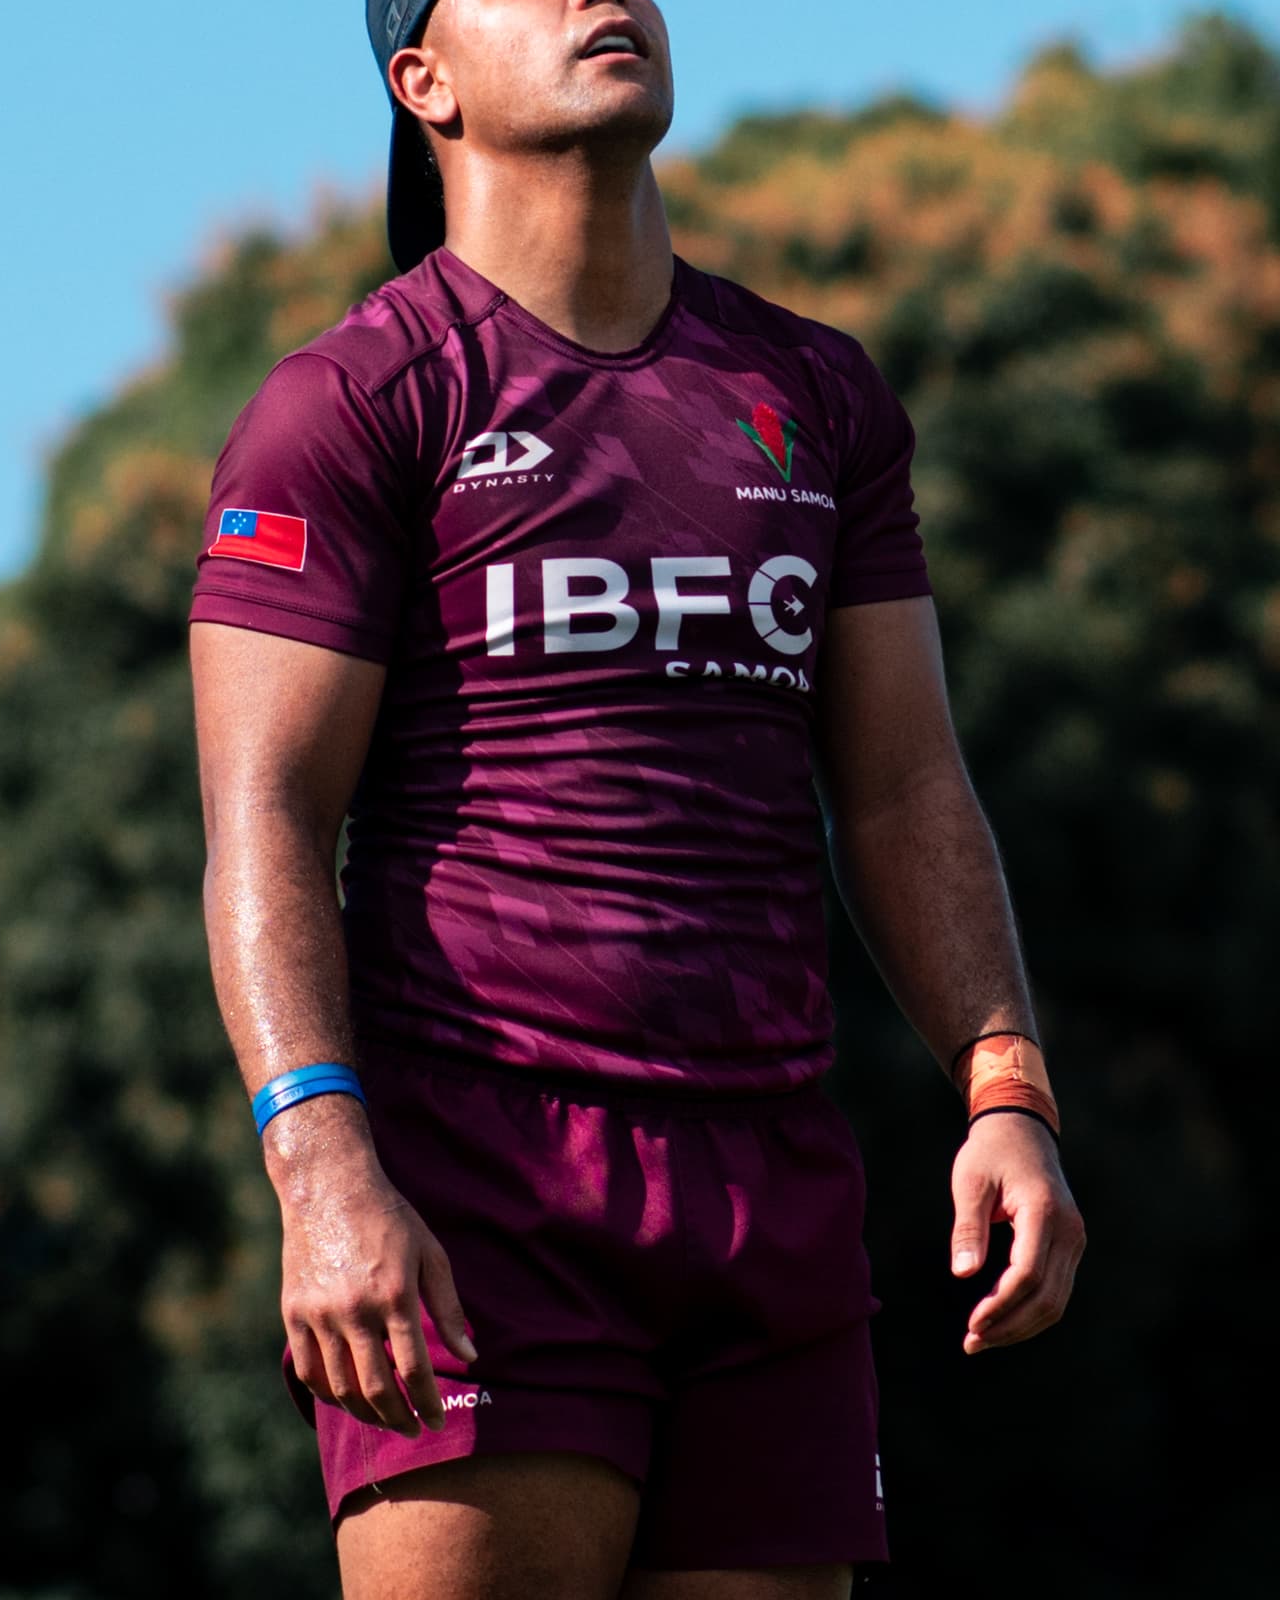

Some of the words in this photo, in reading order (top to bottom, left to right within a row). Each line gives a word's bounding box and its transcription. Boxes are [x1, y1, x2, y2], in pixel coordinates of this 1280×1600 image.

[453, 474, 554, 493] DYNASTY
[735, 487, 787, 501] MANU
[791, 489, 836, 511] SAMOA
[485, 554, 818, 656] IBFC
